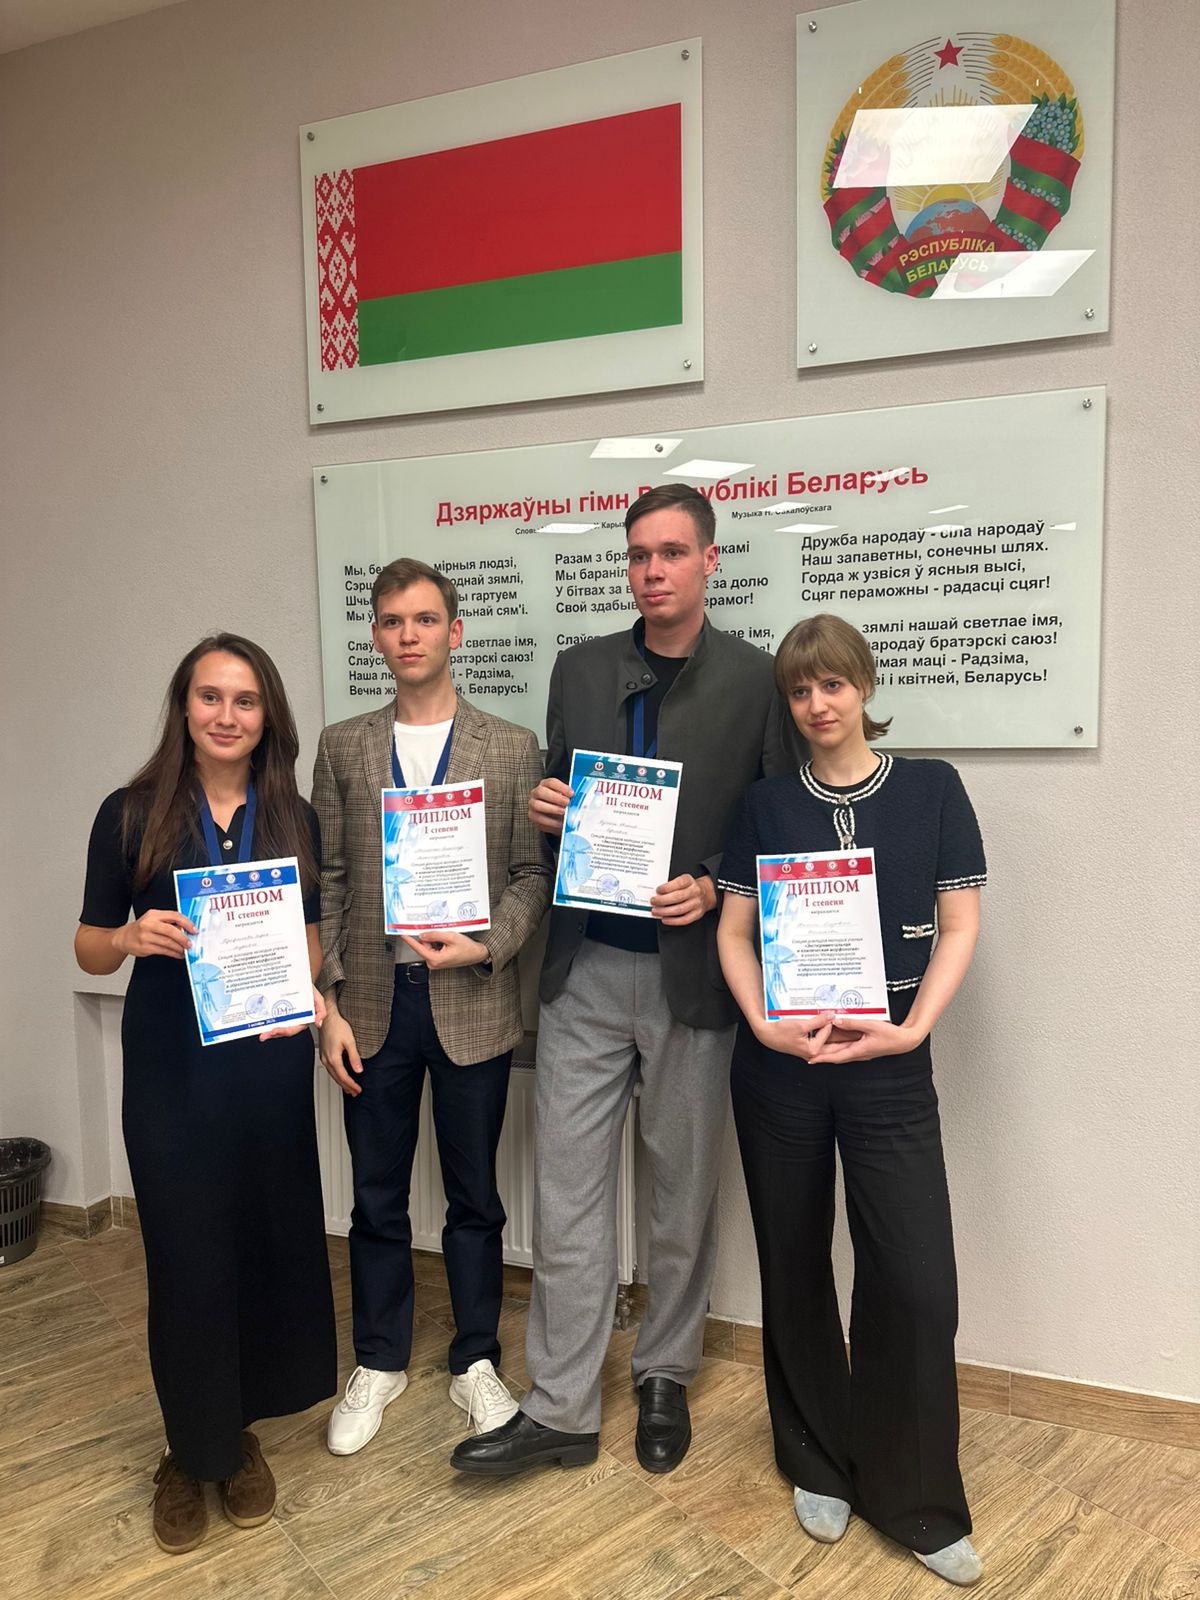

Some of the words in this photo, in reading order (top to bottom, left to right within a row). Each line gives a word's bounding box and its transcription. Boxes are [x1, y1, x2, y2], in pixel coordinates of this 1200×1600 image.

[899, 237, 996, 267] РЭСПУБЛІКА
[906, 257, 989, 284] БЕЛАРУСЬ
[436, 499, 571, 527] Дзяржаўны
[579, 495, 628, 512] гімн
[787, 468, 928, 495] Беларусь
[801, 533, 857, 551] Дружба
[863, 528, 925, 546] народаў
[978, 520, 1045, 538] народаў
[555, 554, 592, 564] Разам
[596, 554, 602, 562] з
[802, 554, 832, 566] Наш
[837, 550, 921, 564] запаветны,
[927, 545, 996, 558] сонечны
[1002, 542, 1048, 553] шлях.
[345, 565, 365, 576] Мы,
[479, 557, 516, 569] людзі,
[802, 572, 843, 586] Горда
[848, 572, 859, 581] ж
[863, 566, 910, 583] узвіся
[915, 565, 923, 580] ў
[928, 564, 978, 576] ясныя
[984, 559, 1025, 573] высі,
[488, 572, 523, 584] зямлі,
[556, 570, 576, 581] Мы
[556, 586, 563, 597] У
[567, 585, 605, 596] бітвах
[609, 586, 621, 594] за
[713, 580, 726, 589] за
[730, 577, 768, 590] долю
[802, 589, 835, 602] Сцяг
[840, 585, 928, 601] пераможны
[944, 578, 1004, 596] радасці
[1010, 576, 1050, 591] сцяг!
[472, 591, 517, 603] гартуем
[347, 611, 364, 621] Мы
[497, 604, 528, 615] сям'і.
[556, 601, 587, 613] Свой
[862, 620, 903, 633] зямлі
[909, 617, 958, 631] нашай
[963, 617, 1027, 629] светлае
[1033, 614, 1062, 627] імя,
[749, 627, 775, 639] імя,
[930, 633, 1006, 651] братэрскі
[1012, 632, 1057, 645] саюз!
[466, 639, 511, 648] светлае
[515, 636, 536, 647] імя,
[501, 651, 533, 662] саюз!
[913, 654, 946, 668] маці
[961, 652, 1028, 667] Радзіма,
[349, 671, 377, 680] Наша
[466, 668, 514, 680] Радзіма,
[890, 673, 893, 685] і
[898, 672, 959, 685] квітней,
[965, 669, 1047, 685] Беларусь!
[350, 685, 381, 695] Вечна
[469, 682, 527, 696] Беларусь!
[594, 781, 664, 801] ДИПЛОМ
[606, 796, 617, 806] III
[620, 801, 649, 811] степени
[408, 807, 472, 825] ДИПЛОМ
[786, 879, 860, 897] ДИПЛОМ
[209, 888, 284, 913] ДИПЛОМ
[805, 898, 809, 907] I
[226, 912, 235, 922] II
[238, 909, 270, 920] степени
